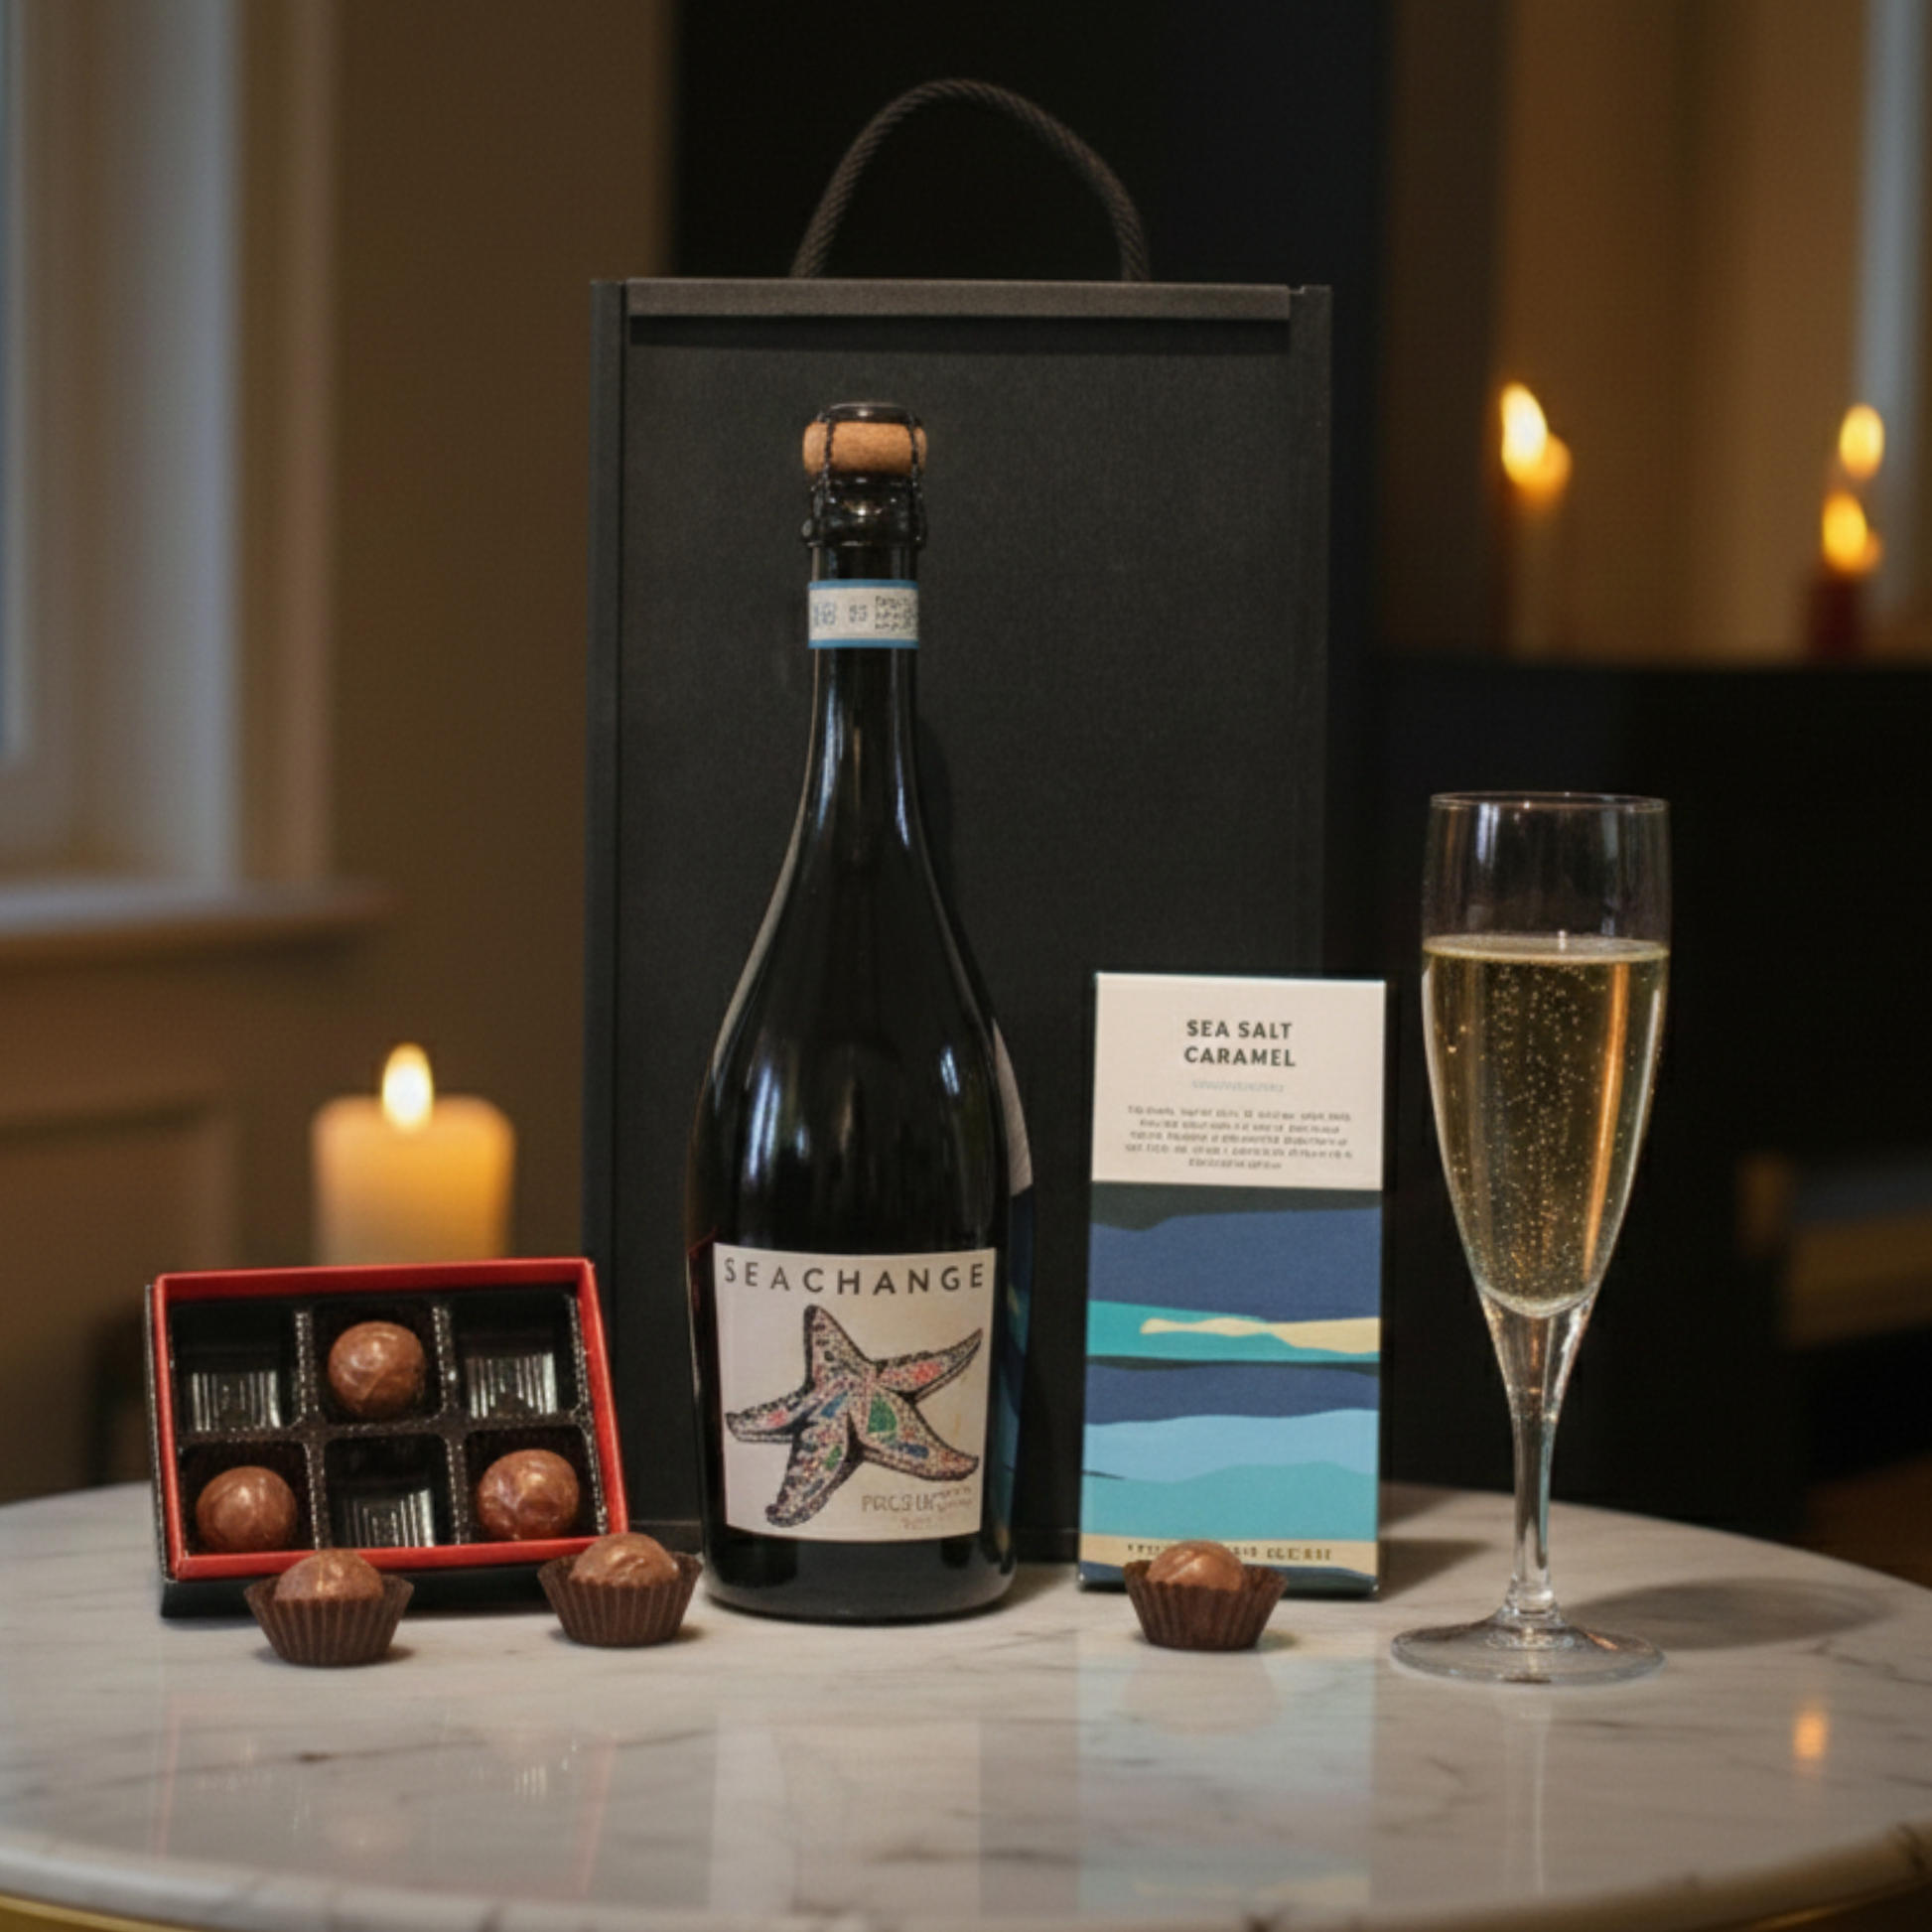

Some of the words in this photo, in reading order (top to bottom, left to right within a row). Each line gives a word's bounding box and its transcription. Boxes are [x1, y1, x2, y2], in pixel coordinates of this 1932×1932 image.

[1186, 1019, 1230, 1037] SEA
[1238, 1021, 1293, 1039] SALT
[1183, 1045, 1296, 1067] CARAMEL
[724, 1257, 984, 1296] SEACHANGE
